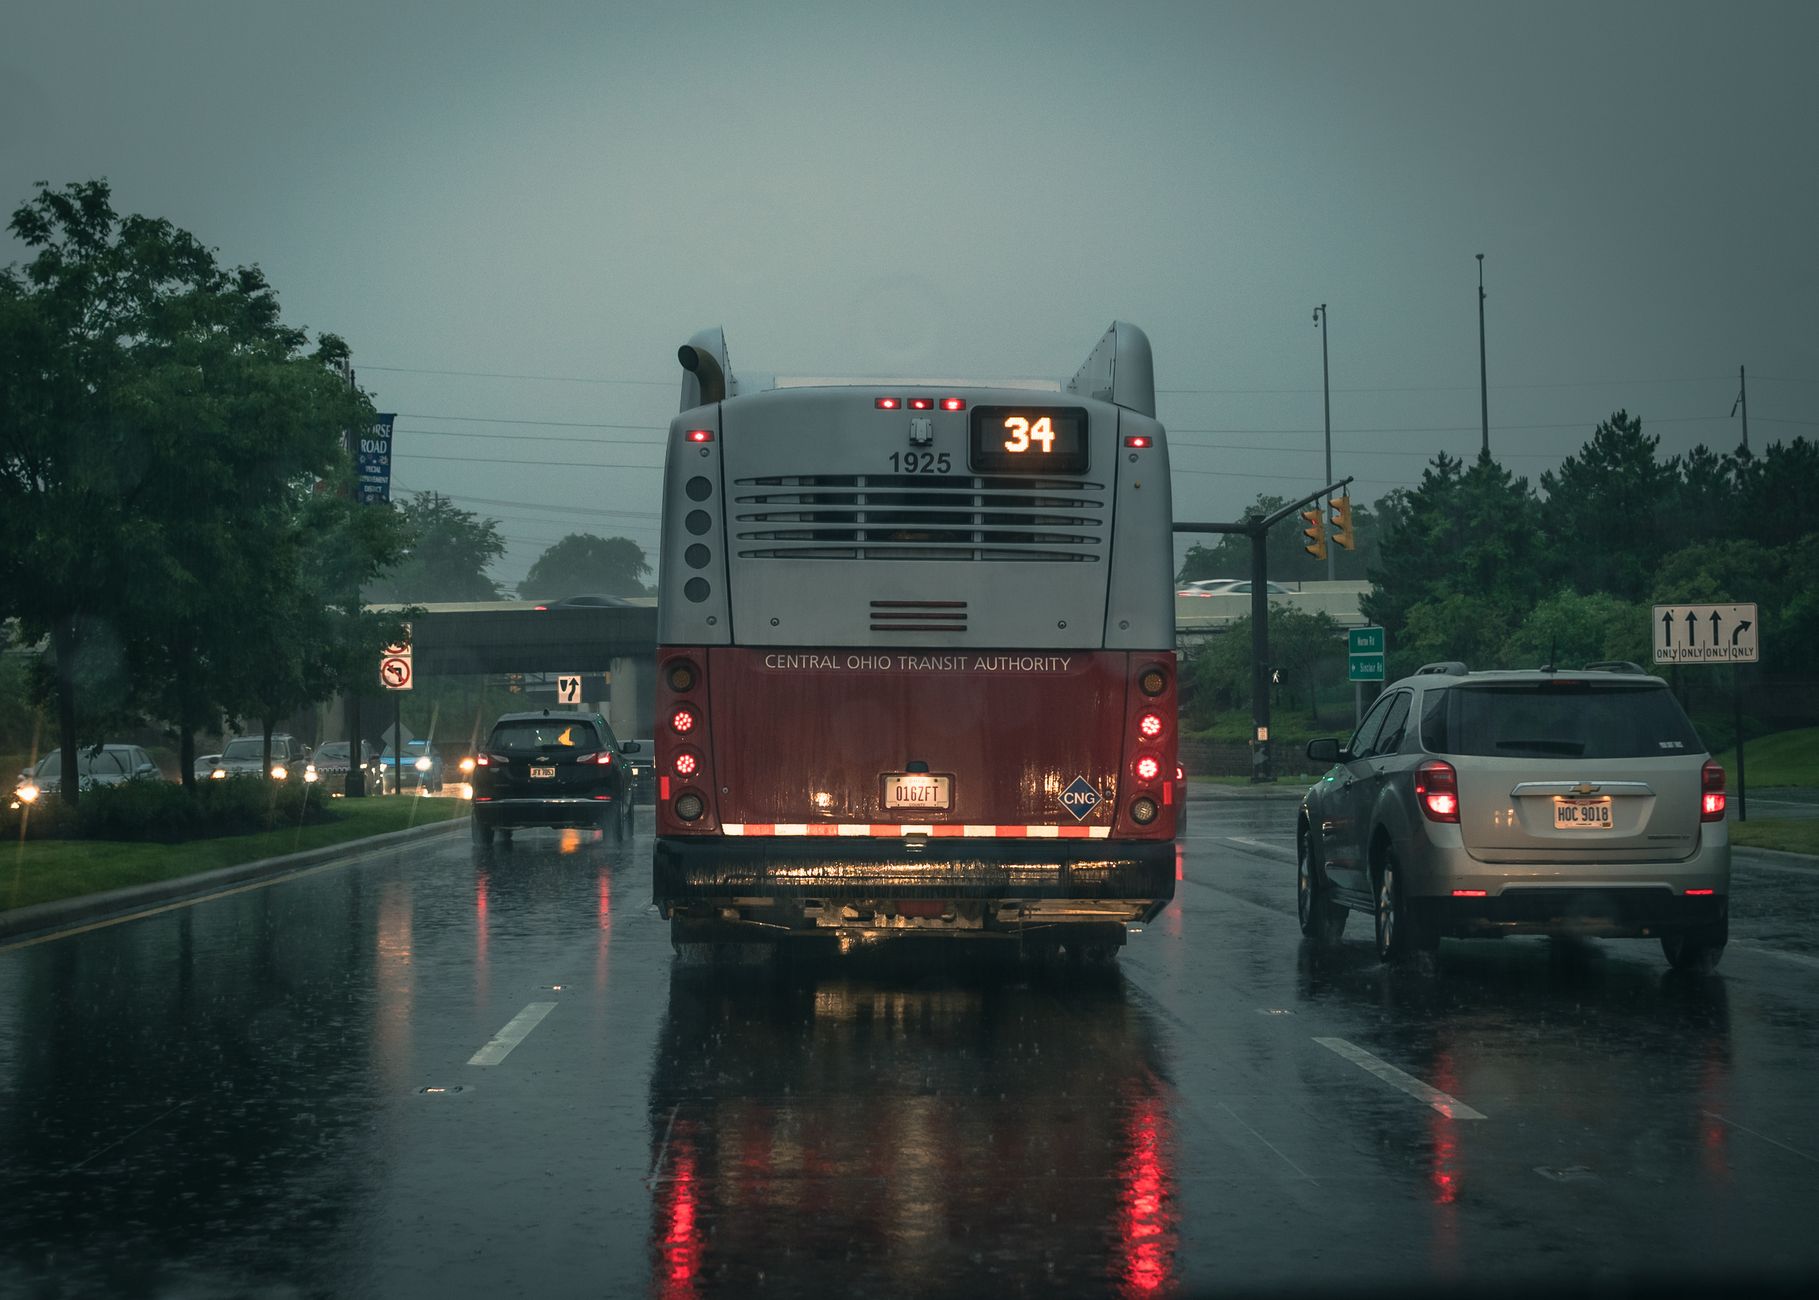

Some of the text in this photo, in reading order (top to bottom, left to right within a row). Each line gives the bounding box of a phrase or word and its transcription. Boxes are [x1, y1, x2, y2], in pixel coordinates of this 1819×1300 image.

[1004, 416, 1055, 453] 34
[361, 440, 387, 454] ROAD
[888, 451, 951, 474] 1925
[1657, 647, 1754, 659] ONLY ONLY ONLY ONLY
[765, 655, 1071, 671] CENTRAL OHIO TRANSIT AUTHORITY
[896, 785, 938, 802] 016ZFT
[1064, 792, 1095, 805] CNG
[1558, 807, 1609, 821] HOC 9018
